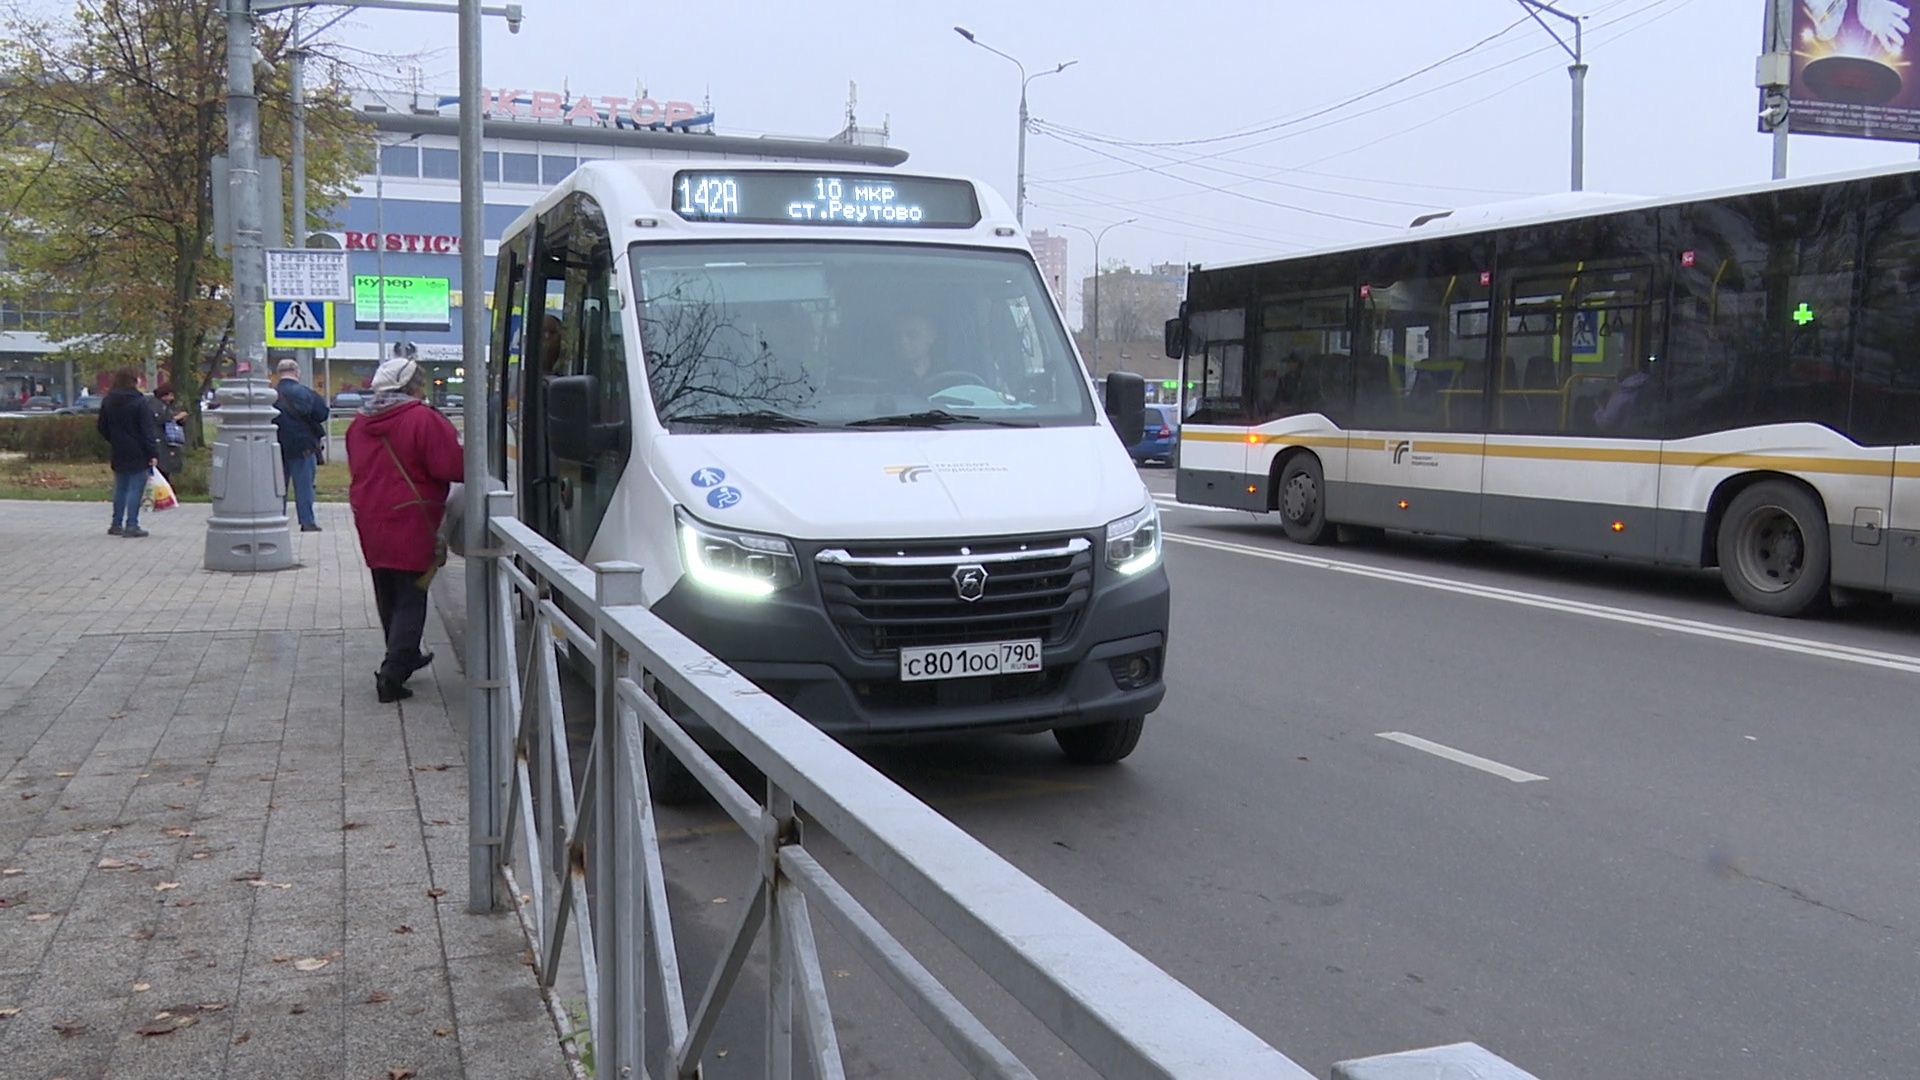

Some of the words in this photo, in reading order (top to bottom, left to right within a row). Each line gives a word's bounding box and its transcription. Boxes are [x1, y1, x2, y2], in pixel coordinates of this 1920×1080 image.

[817, 177, 842, 200] 10
[855, 186, 895, 203] мкр
[788, 199, 923, 222] ст.Реутово
[345, 231, 463, 253] ROSTIC'
[1002, 643, 1035, 663] 790
